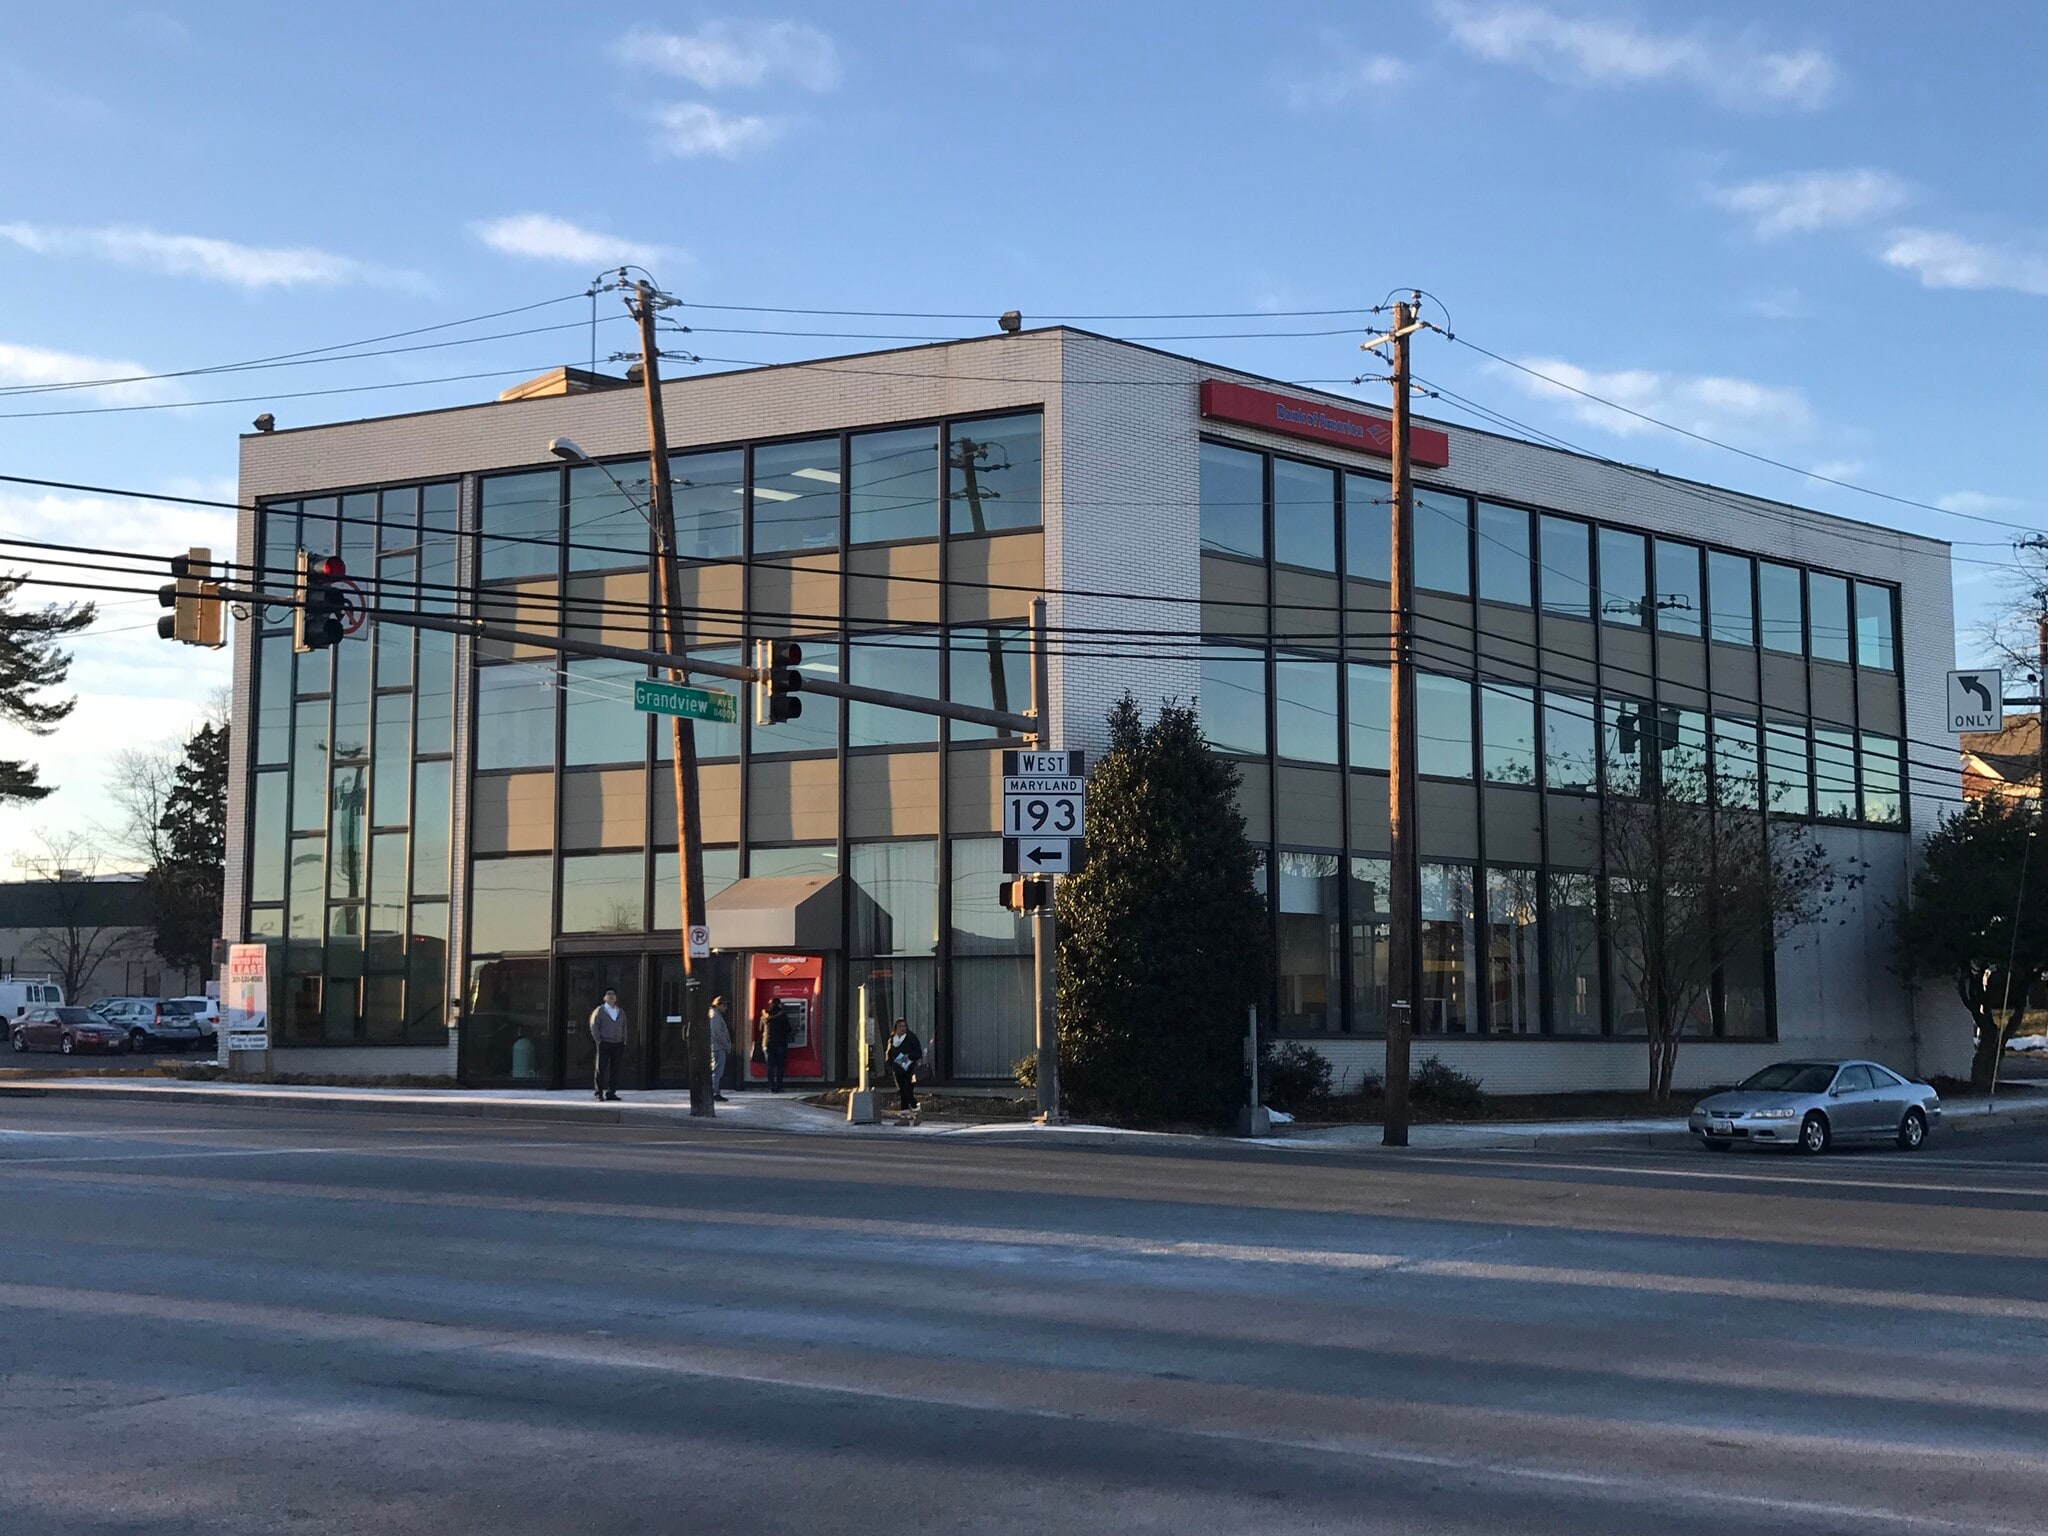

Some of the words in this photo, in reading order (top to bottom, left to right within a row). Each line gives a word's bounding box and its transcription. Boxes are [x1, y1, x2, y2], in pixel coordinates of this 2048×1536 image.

[1276, 403, 1305, 425] Bank
[1306, 411, 1318, 427] of
[1319, 413, 1364, 438] America
[636, 687, 708, 714] Grandview
[717, 698, 733, 709] AVE
[1955, 715, 1994, 727] ONLY
[1023, 755, 1064, 771] WEST
[1010, 781, 1077, 790] MARYLAND
[1012, 799, 1076, 831] 193
[233, 964, 263, 974] LEASE
